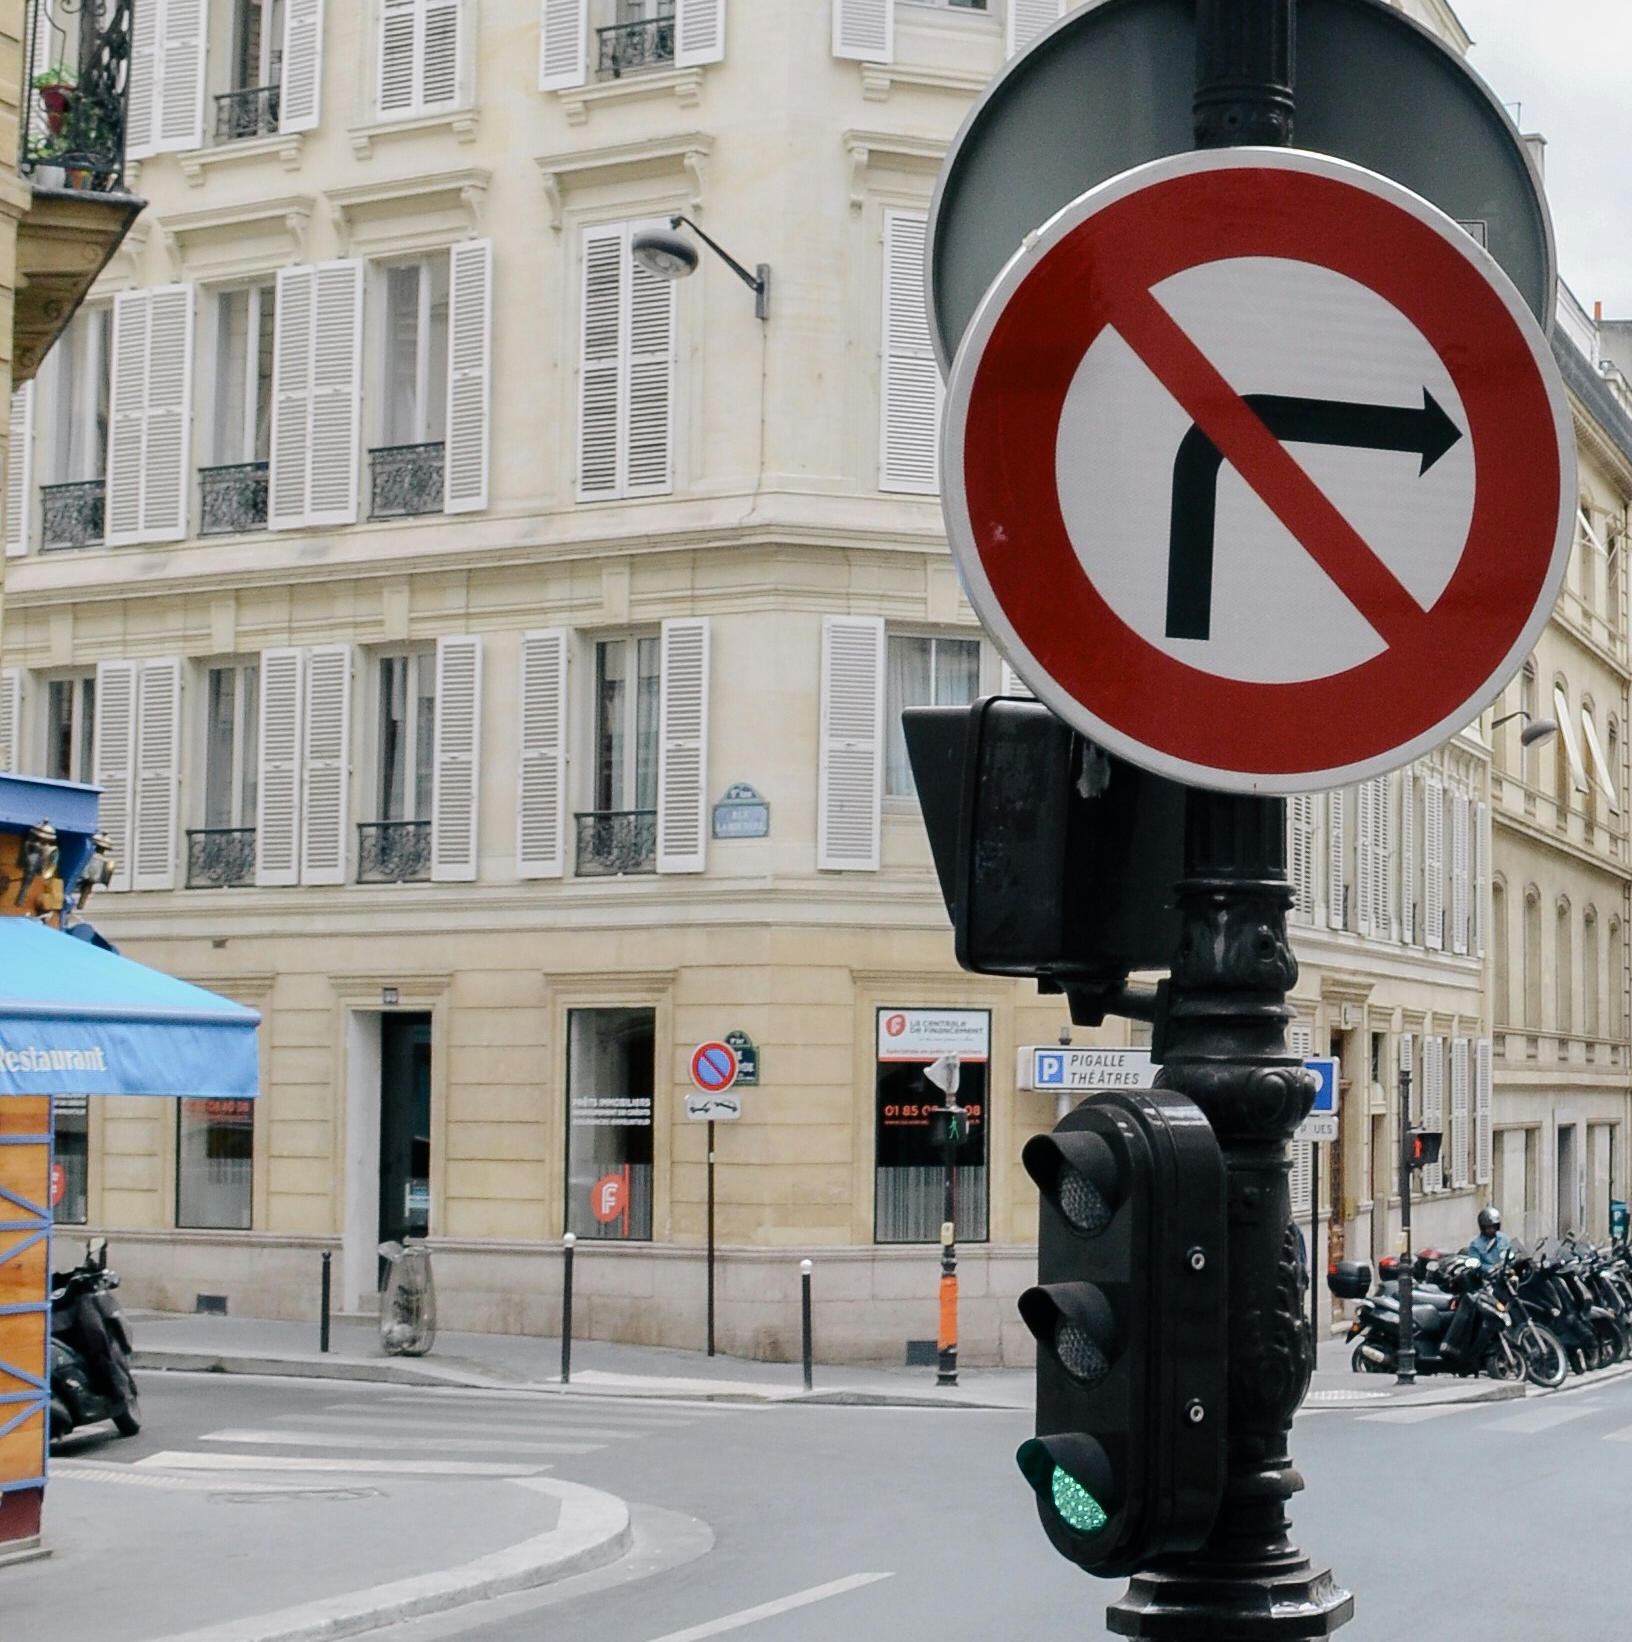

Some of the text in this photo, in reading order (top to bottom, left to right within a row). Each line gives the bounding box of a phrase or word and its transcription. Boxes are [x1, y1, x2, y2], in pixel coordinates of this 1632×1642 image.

[1070, 1055, 1125, 1067] PIGALLE
[1042, 1058, 1059, 1081] P
[1071, 1070, 1139, 1085] THÉÂTRES
[884, 1105, 899, 1117] 01
[902, 1105, 919, 1117] 85
